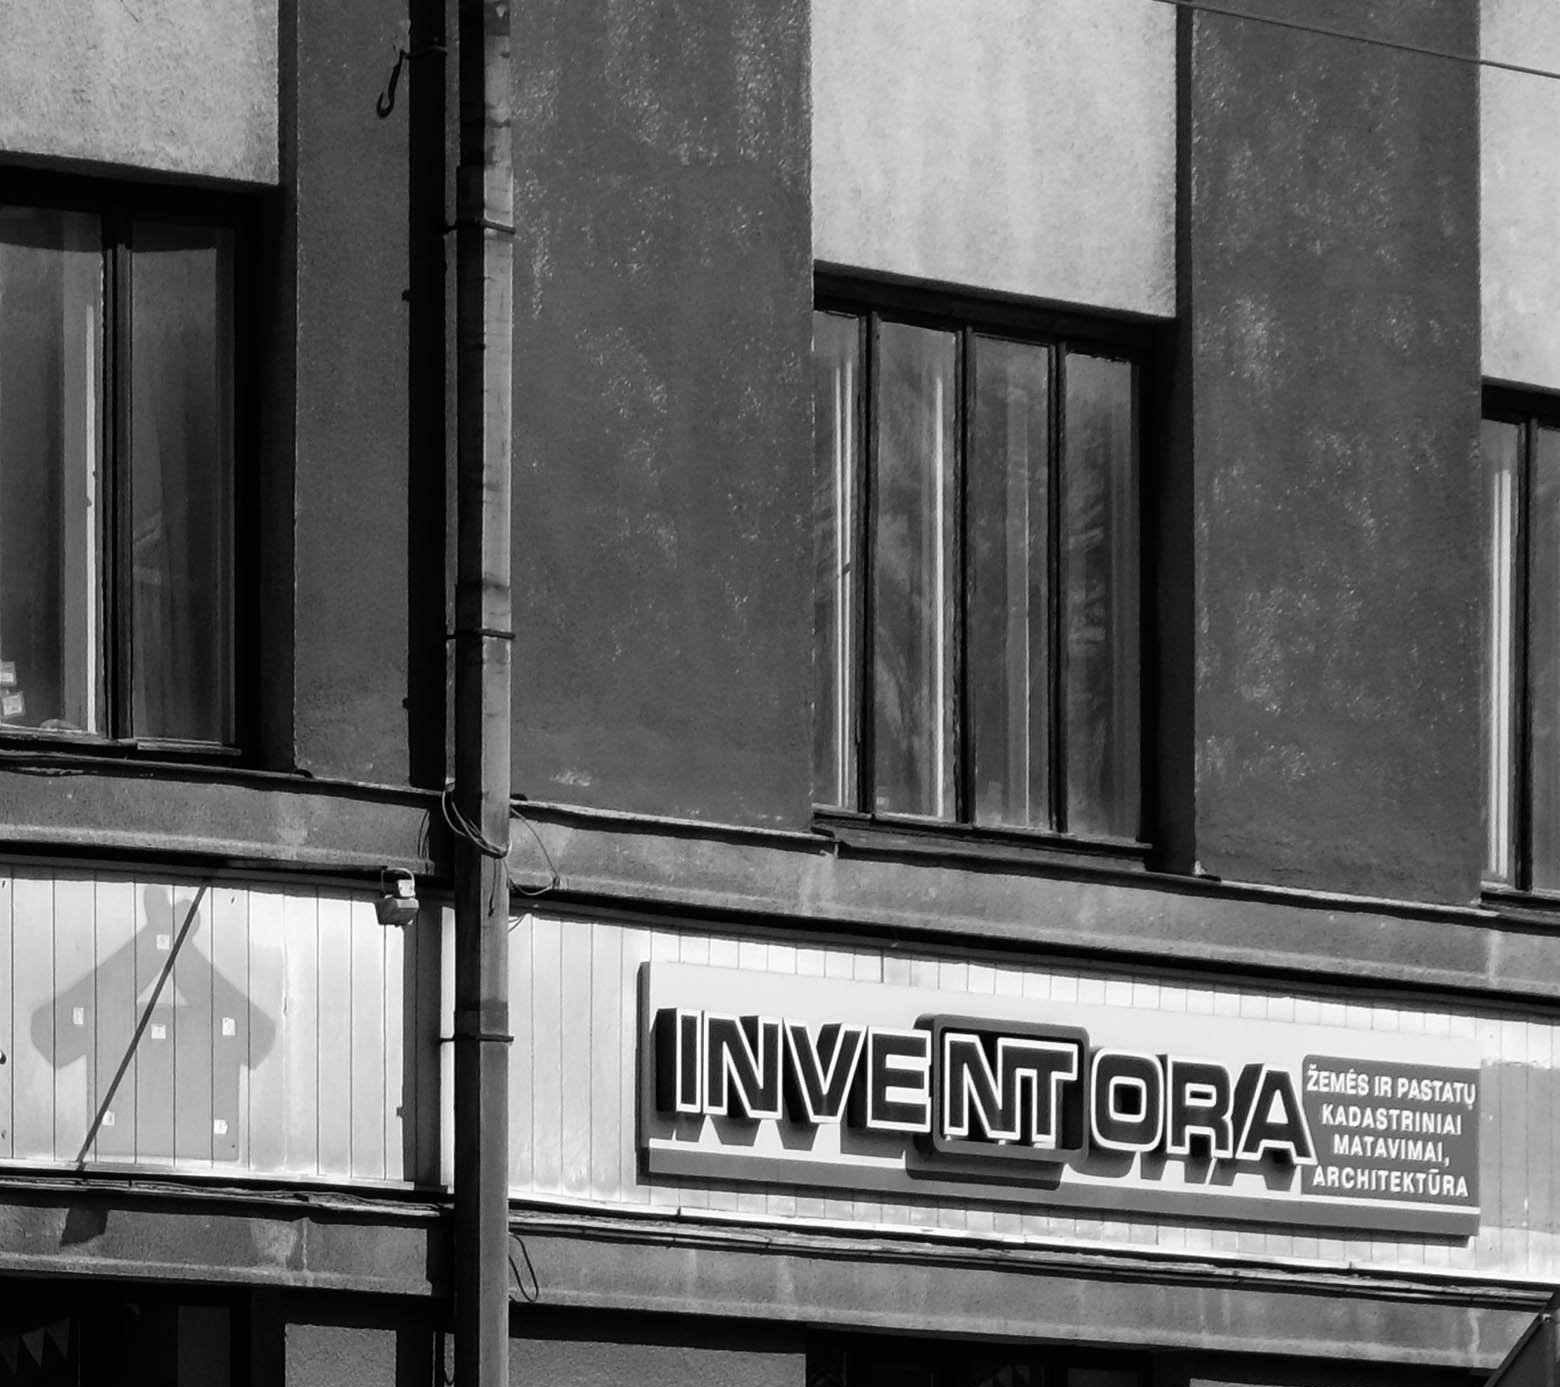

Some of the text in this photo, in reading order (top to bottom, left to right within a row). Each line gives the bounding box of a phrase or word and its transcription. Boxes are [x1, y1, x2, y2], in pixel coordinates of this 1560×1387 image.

[656, 1007, 1318, 1165] INVENTORA
[1306, 1063, 1477, 1111] ŽEMĖS IR PASTATŲ
[1321, 1102, 1463, 1136] KADASTRINIAI
[1333, 1133, 1451, 1168] MATAVIMAI,
[1311, 1164, 1470, 1198] ARCHITEKTŪRA
